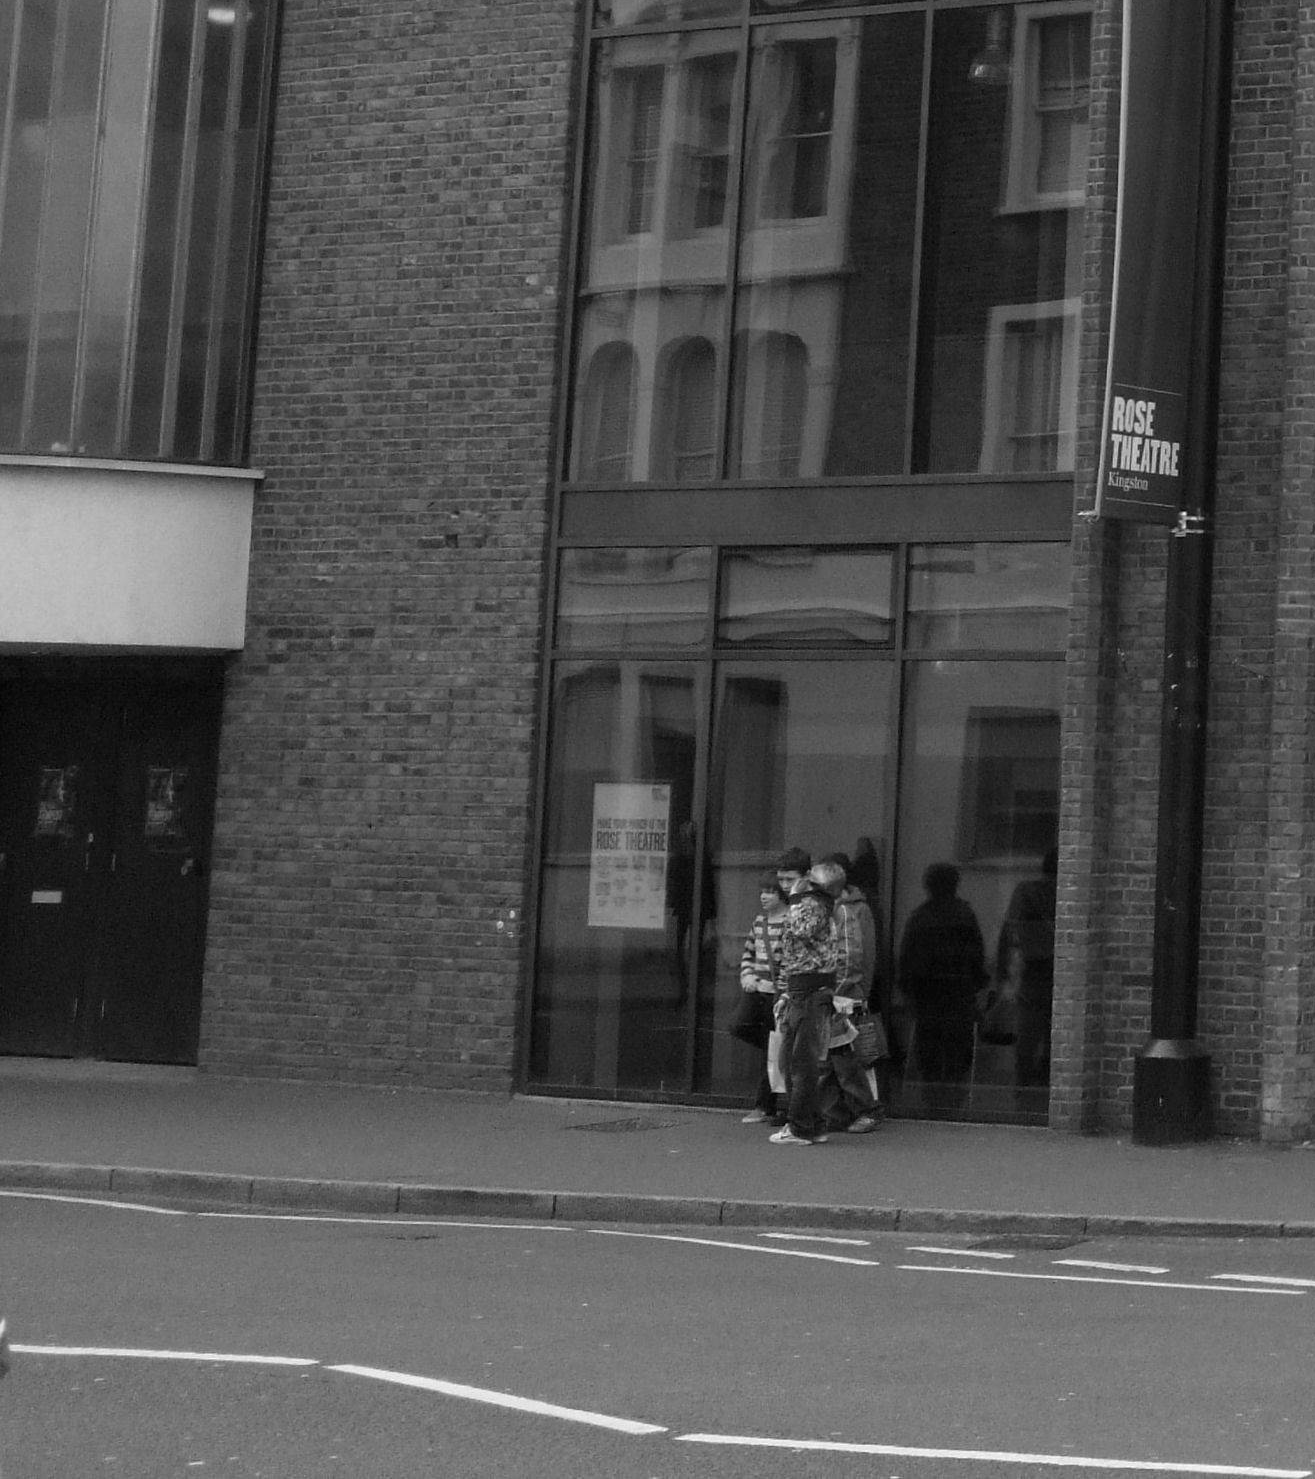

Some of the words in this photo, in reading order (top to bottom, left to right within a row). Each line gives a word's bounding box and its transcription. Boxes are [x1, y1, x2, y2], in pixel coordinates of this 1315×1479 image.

[1112, 396, 1156, 436] ROSE
[1111, 433, 1180, 477] THEATRE
[1108, 472, 1148, 491] Kingston
[596, 830, 621, 850] ROSE
[625, 831, 666, 851] THEATRE
